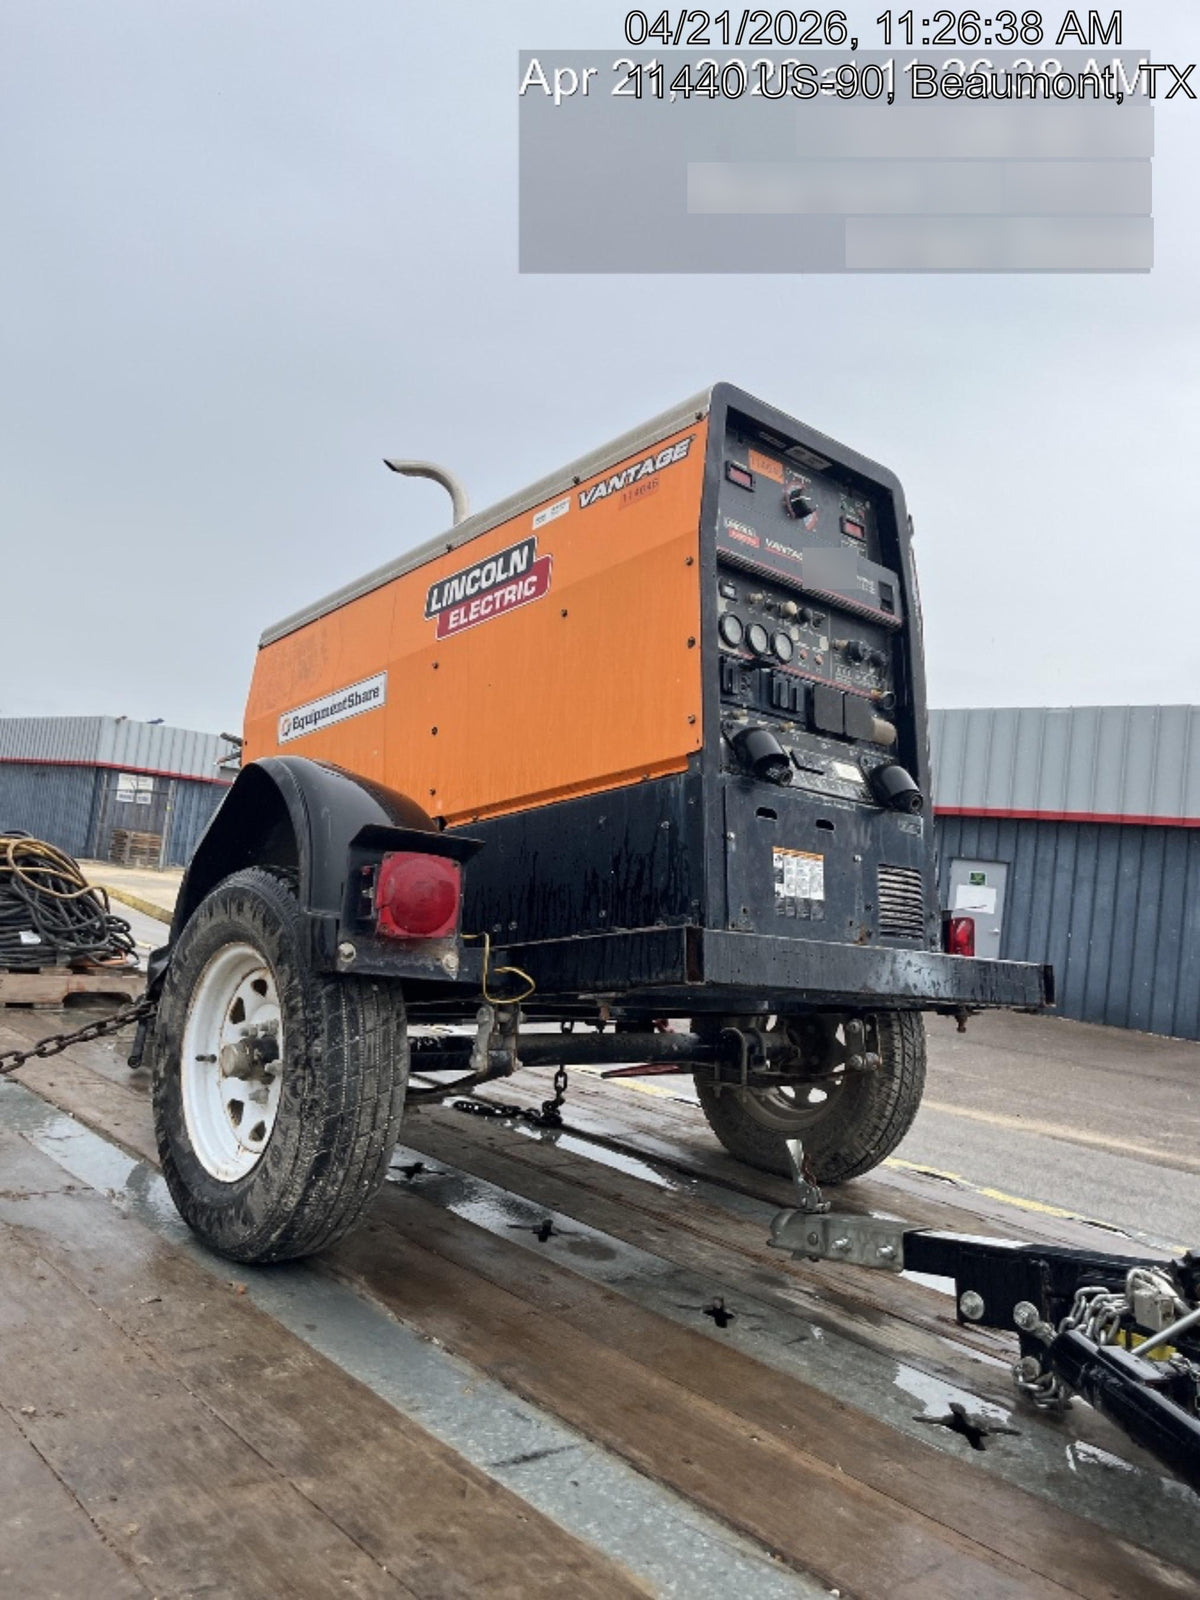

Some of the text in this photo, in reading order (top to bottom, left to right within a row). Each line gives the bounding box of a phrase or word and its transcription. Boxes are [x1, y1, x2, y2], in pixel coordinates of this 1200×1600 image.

[578, 434, 696, 509] VANTAGE
[430, 545, 529, 612] LINCOLN
[448, 575, 537, 630] ELECTRIC
[292, 686, 380, 731] EquipmentShare
